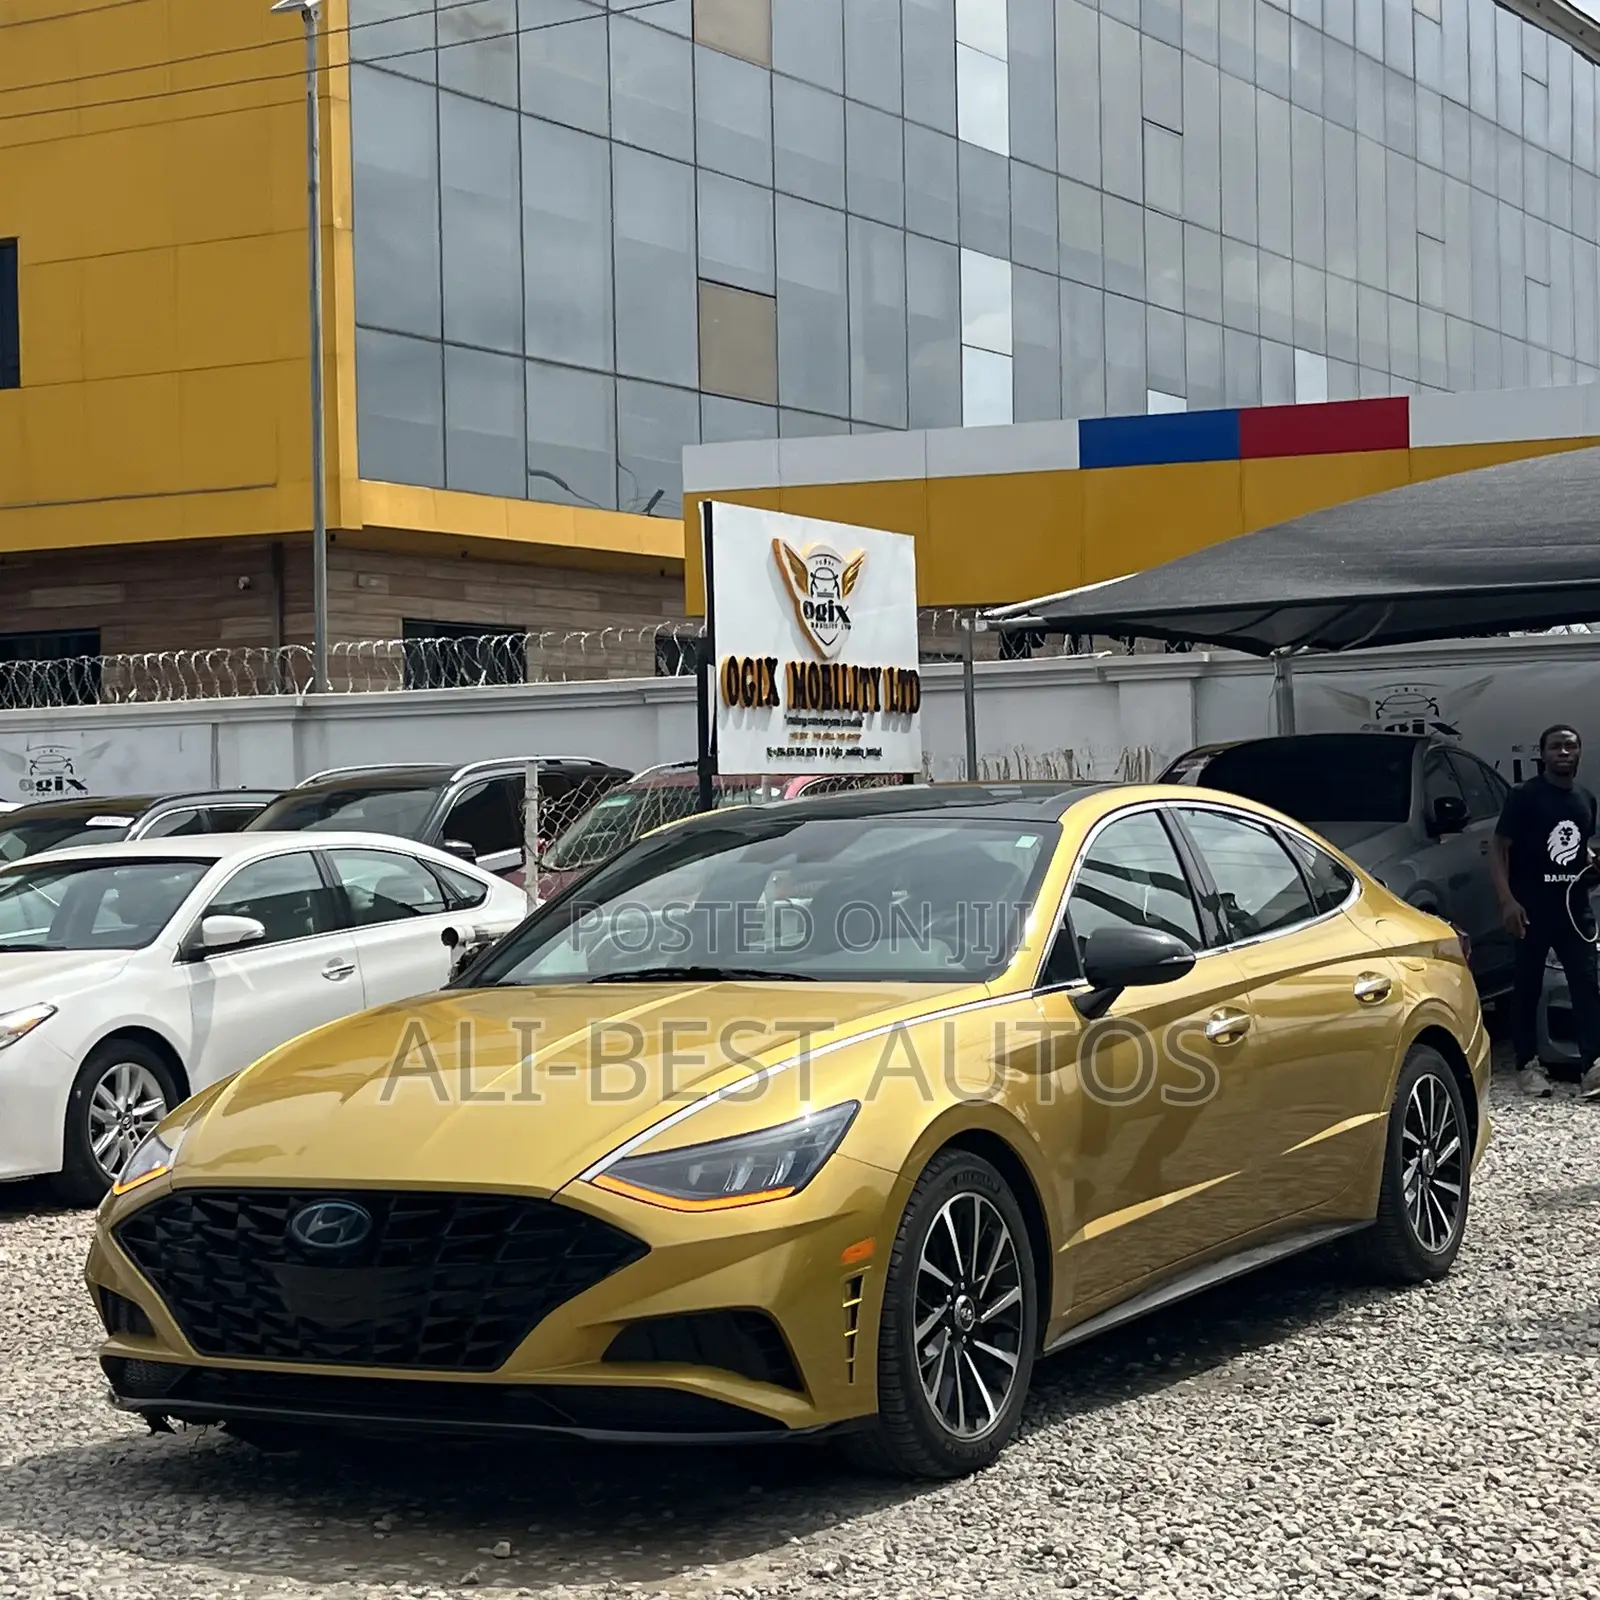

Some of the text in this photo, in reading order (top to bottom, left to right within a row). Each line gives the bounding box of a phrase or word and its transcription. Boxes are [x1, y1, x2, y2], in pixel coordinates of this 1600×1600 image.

[803, 599, 851, 623] ogix
[721, 656, 921, 714] OGIX MOBILITY LTD
[19, 776, 88, 792] ogix
